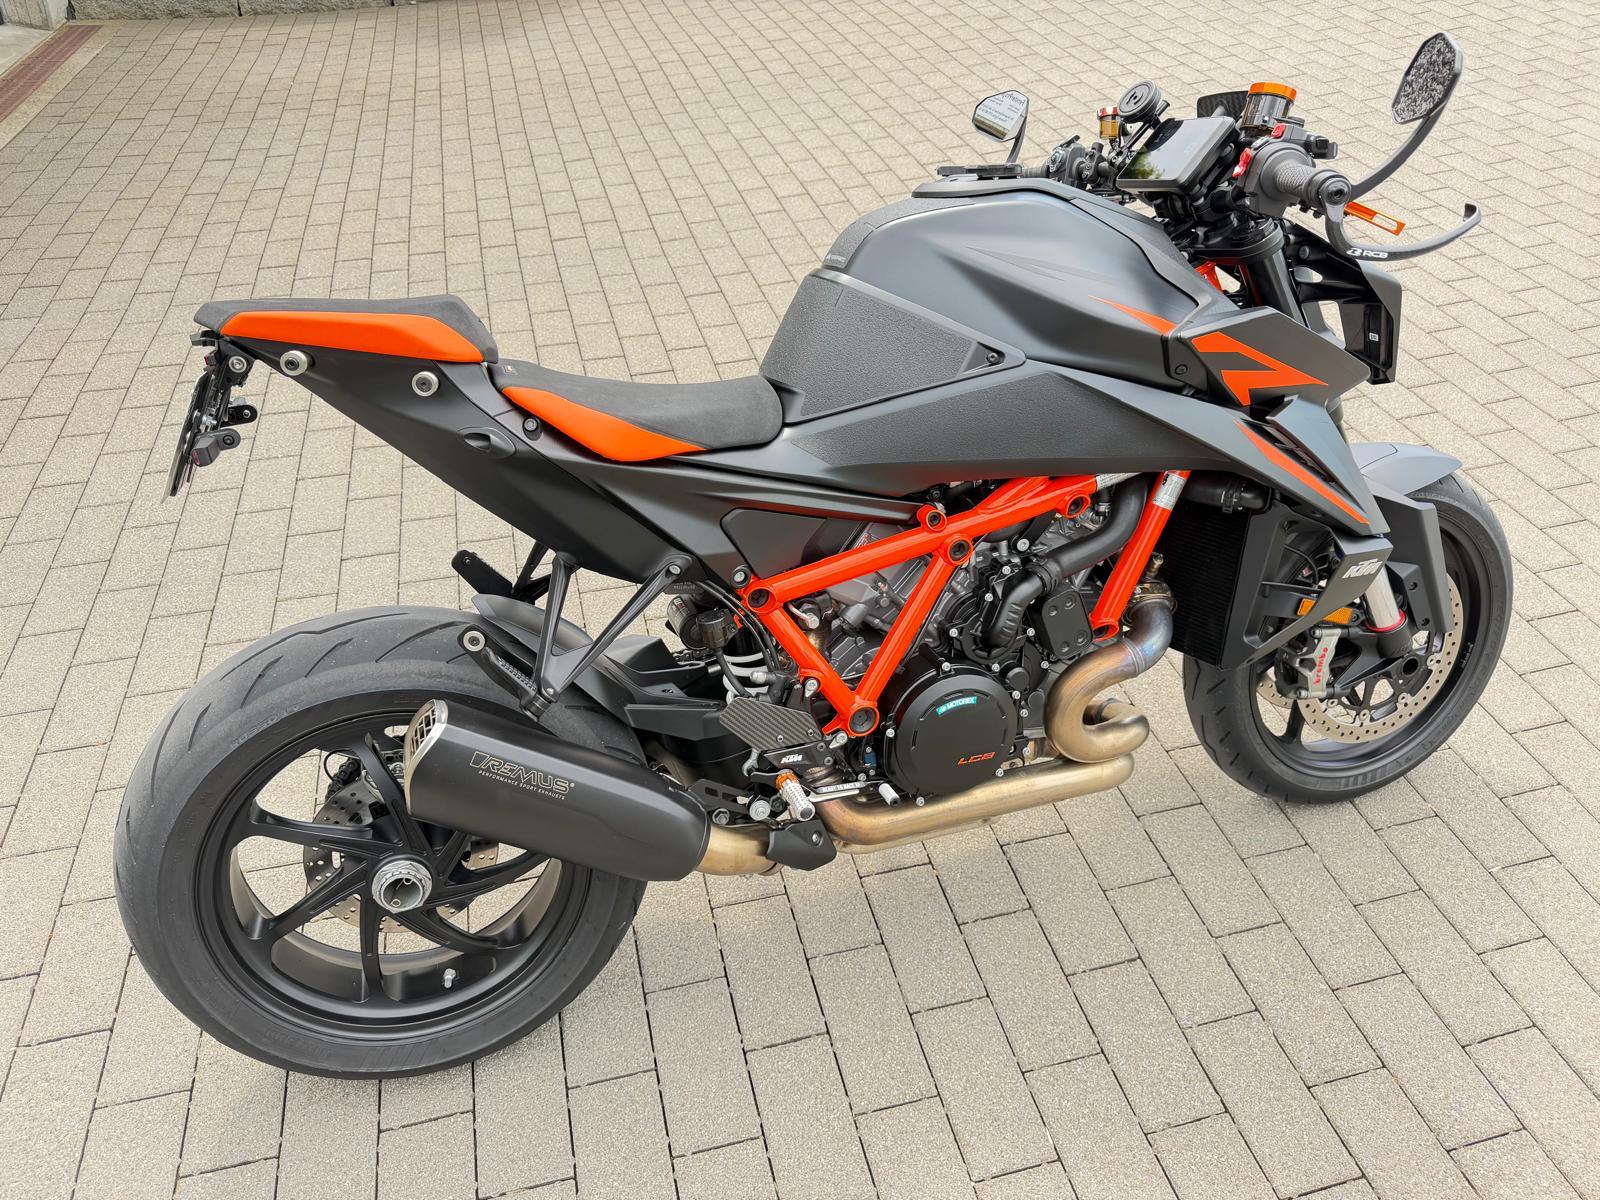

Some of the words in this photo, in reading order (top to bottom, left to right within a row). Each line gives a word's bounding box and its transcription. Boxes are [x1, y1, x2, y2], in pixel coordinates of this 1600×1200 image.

[1362, 250, 1389, 258] RCB
[1341, 558, 1383, 579] KTM
[1312, 647, 1329, 686] brembo
[946, 697, 977, 709] MOTOREX
[780, 753, 803, 764] KTM
[478, 770, 519, 786] PERFORMANCE
[519, 782, 537, 792] SPORT
[537, 787, 565, 800] EXHAUSTS
